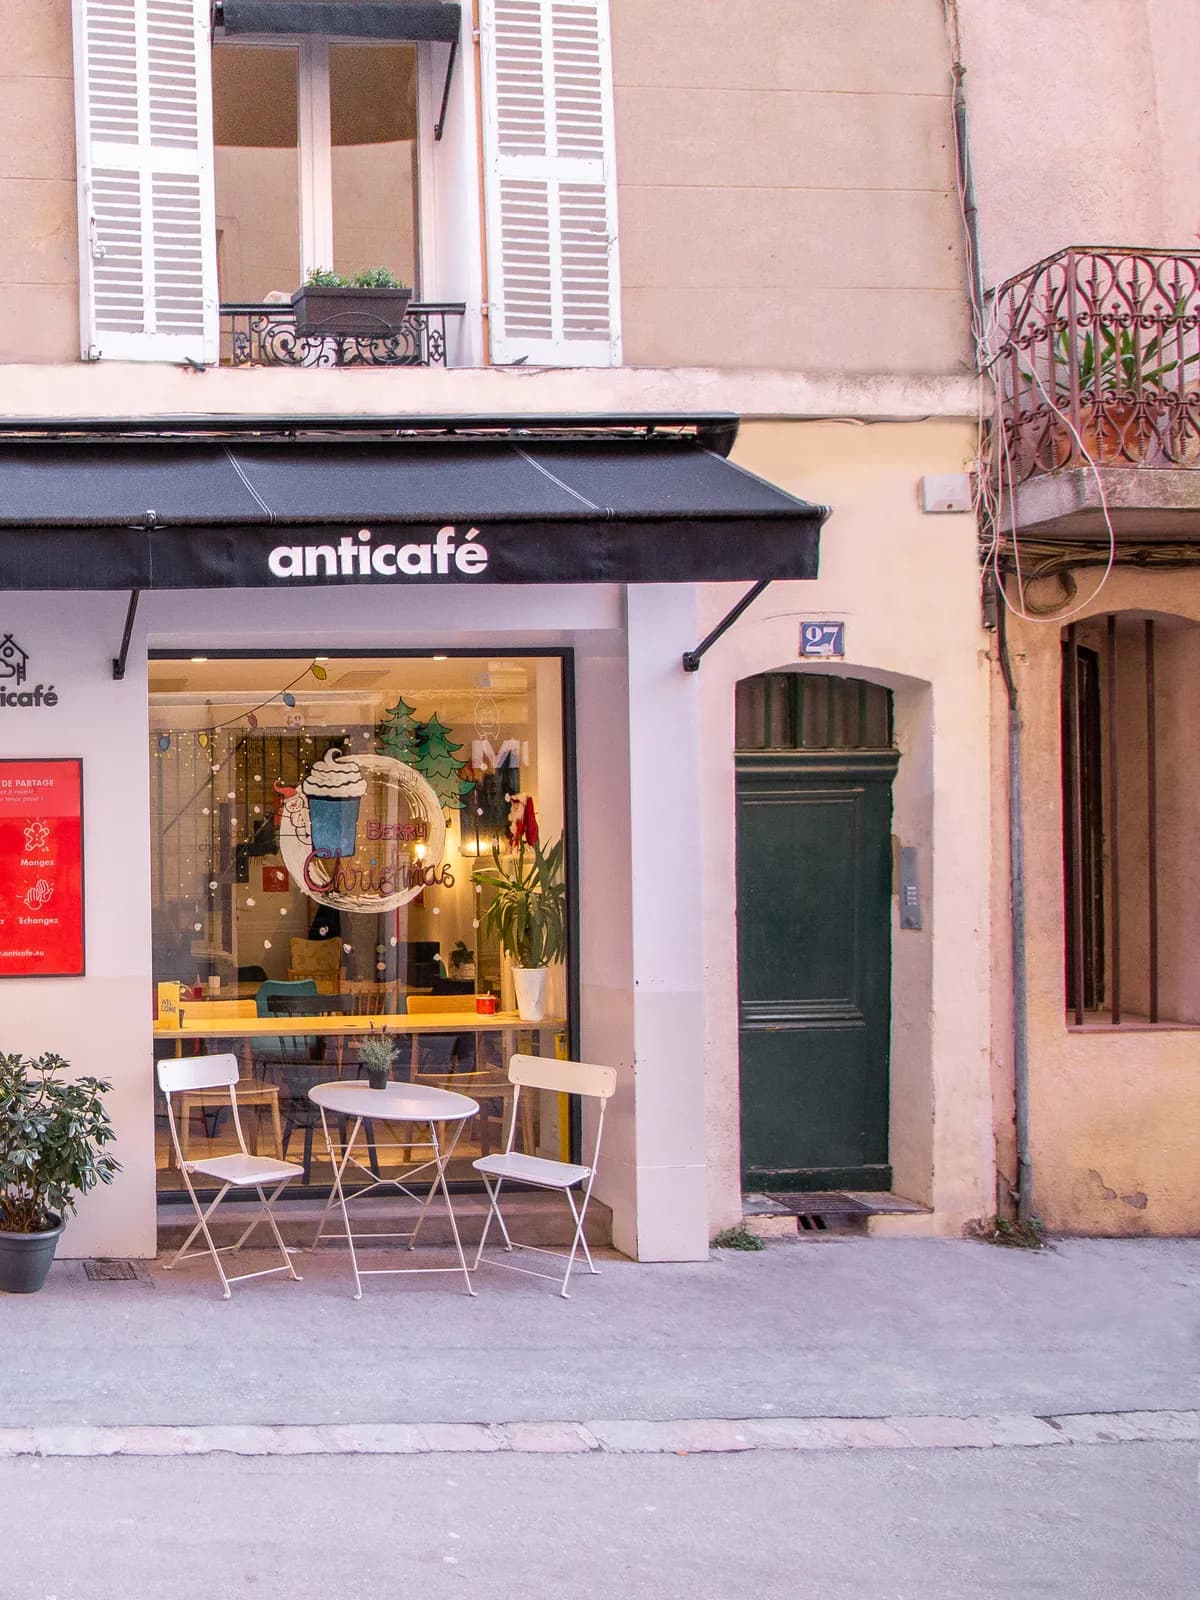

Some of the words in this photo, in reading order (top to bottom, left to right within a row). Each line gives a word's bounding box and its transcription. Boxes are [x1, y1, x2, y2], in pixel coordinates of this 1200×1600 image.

[268, 526, 489, 578] anticafé
[805, 626, 840, 654] 27
[1, 779, 13, 788] DE
[15, 778, 54, 787] PARTAGE
[366, 819, 428, 841] BERRY
[20, 859, 55, 868] Mangez
[303, 848, 455, 895] Christmas
[18, 916, 59, 925] Echangez
